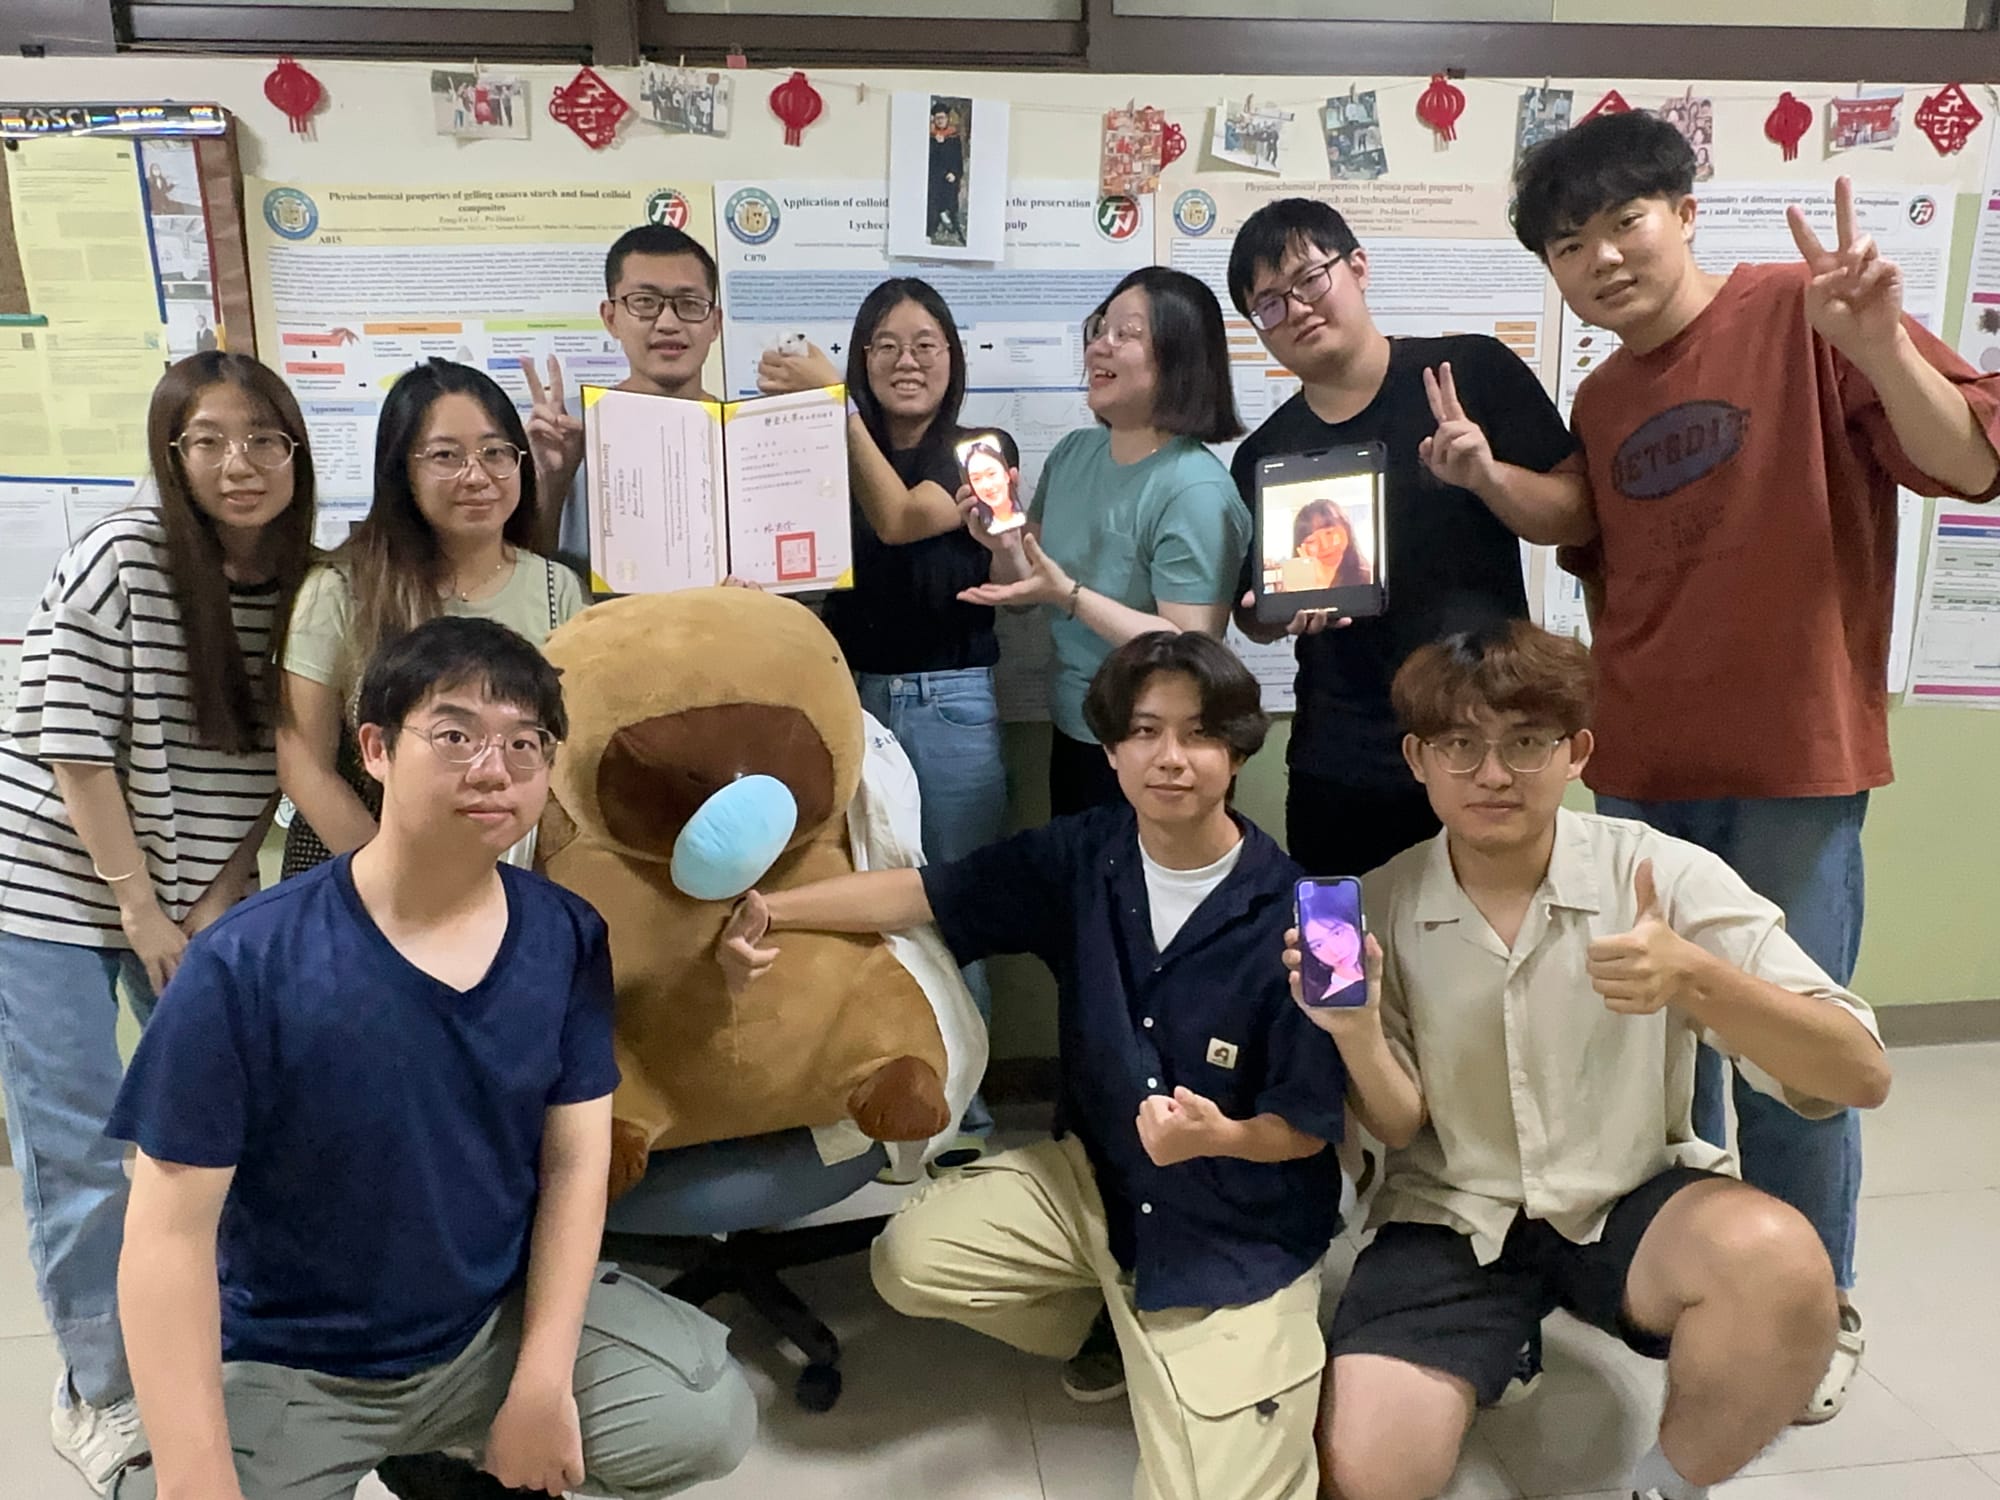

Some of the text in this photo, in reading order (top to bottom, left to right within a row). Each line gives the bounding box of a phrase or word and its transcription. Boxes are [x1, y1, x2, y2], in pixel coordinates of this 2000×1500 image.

[1245, 181, 1474, 193] Physicochemical properties of tapioca pearls prepared by
[329, 189, 631, 203] Physicochemical properties of gelling cassava starch and food colloid
[1343, 195, 1359, 204] and
[1697, 196, 1738, 204] nctionality
[1741, 195, 1749, 203] of
[1750, 195, 1783, 203] different
[458, 203, 506, 214] composites
[784, 197, 889, 209] Application of colloid
[1012, 197, 1091, 209] the preservation
[1715, 207, 1730, 215] and
[1743, 207, 1783, 216] application
[849, 219, 885, 232] Lychee
[1004, 220, 1028, 232] pulp
